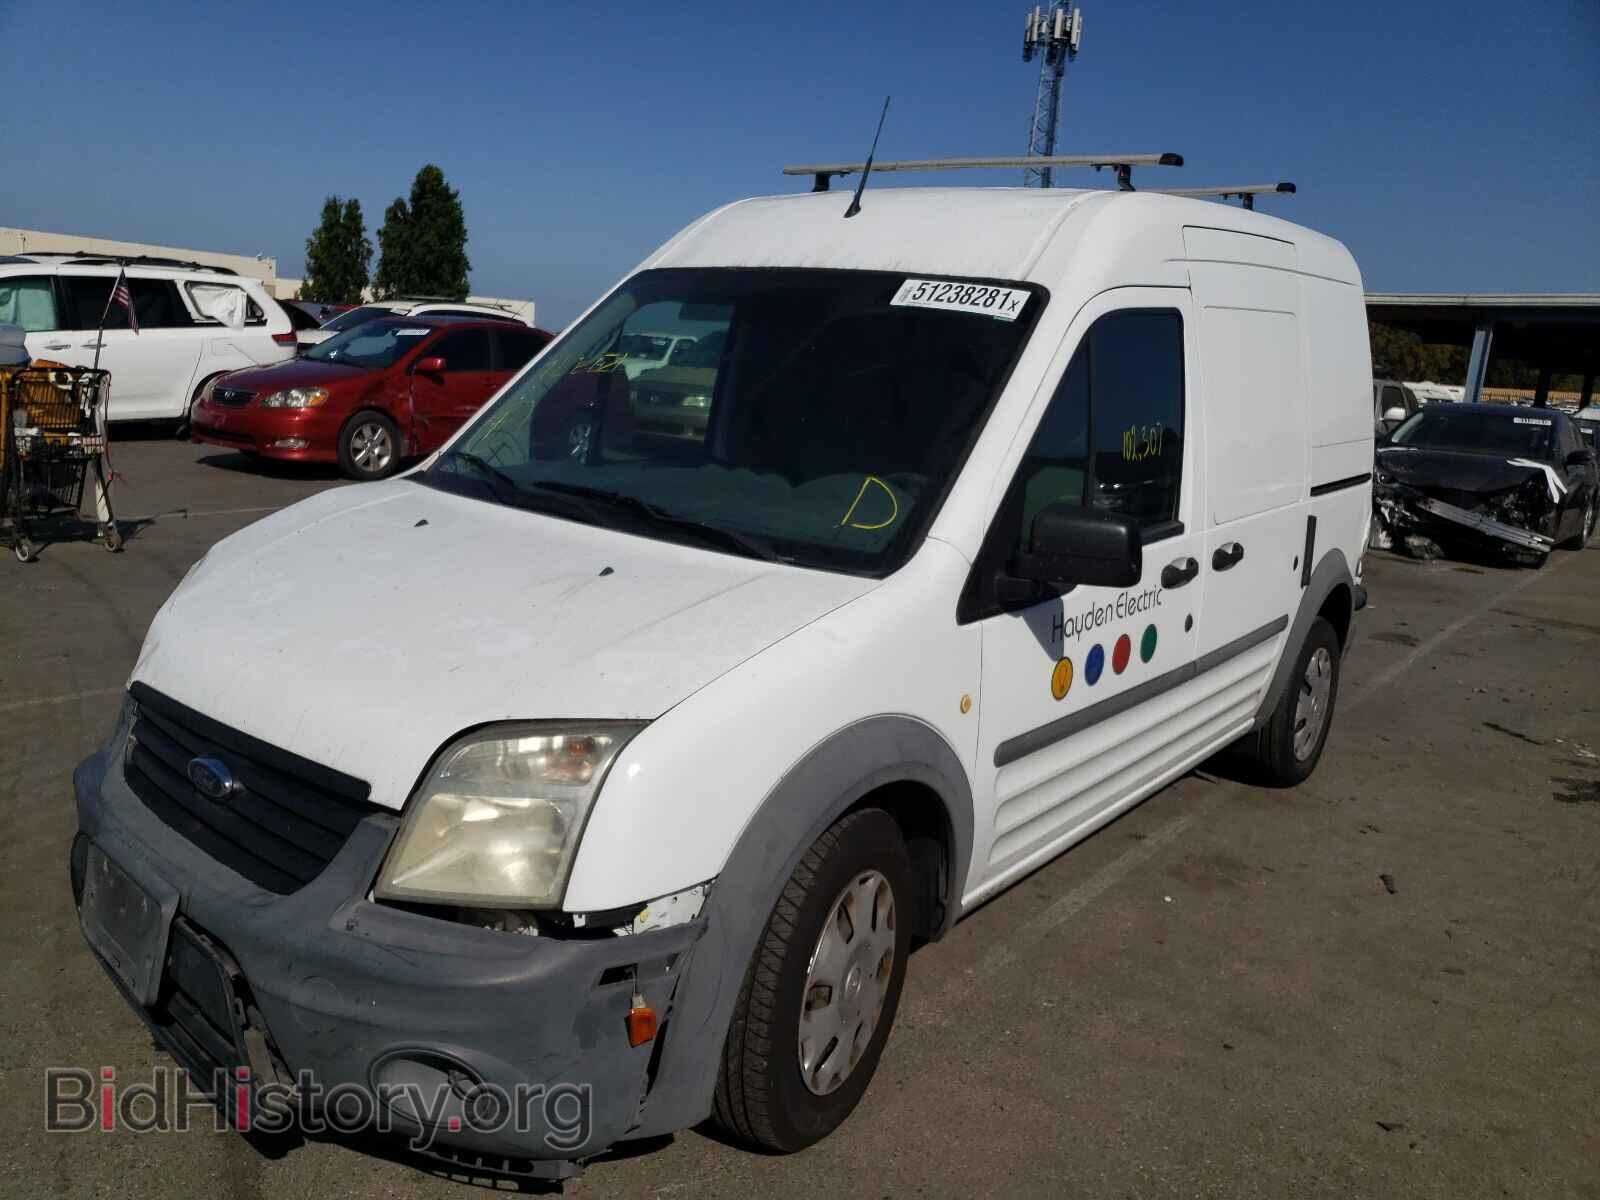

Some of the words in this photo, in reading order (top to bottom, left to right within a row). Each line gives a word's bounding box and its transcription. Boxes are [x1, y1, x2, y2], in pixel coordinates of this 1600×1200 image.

[841, 476, 897, 529] D
[1051, 602, 1113, 642] Hayden
[1116, 585, 1162, 619] Electric
